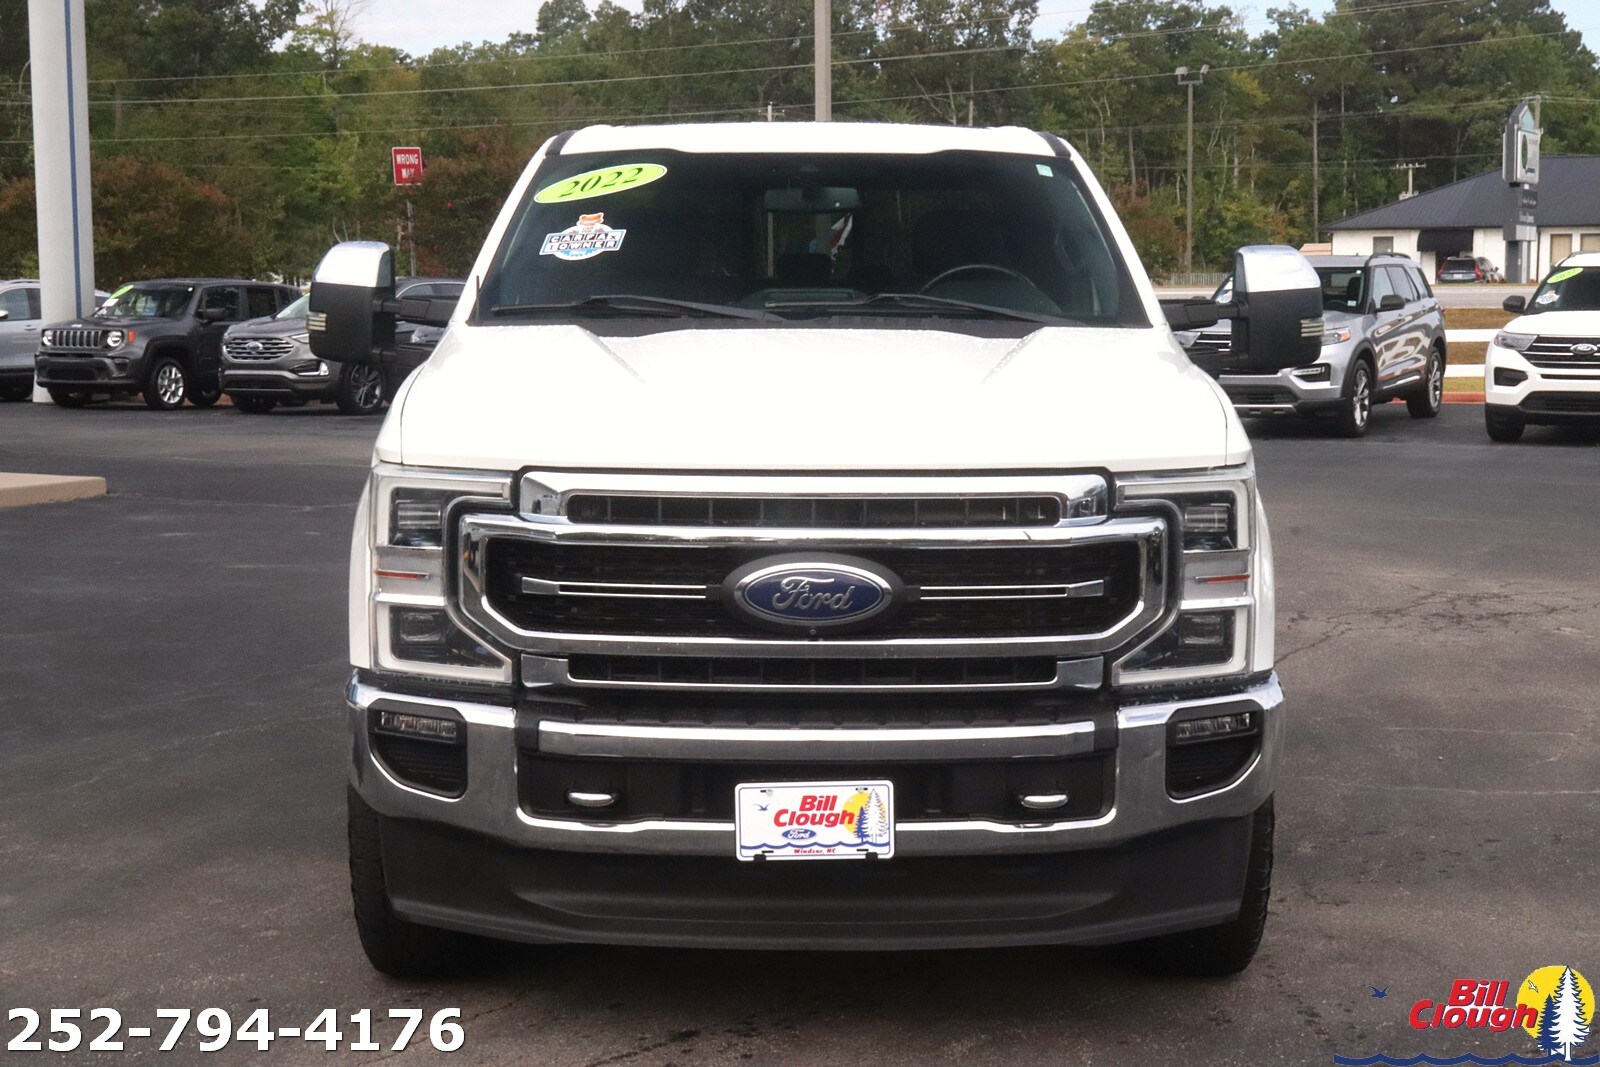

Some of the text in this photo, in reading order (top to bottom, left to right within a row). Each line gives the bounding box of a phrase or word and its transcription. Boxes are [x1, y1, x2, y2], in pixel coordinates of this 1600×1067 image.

[395, 153, 419, 165] WRONG
[401, 168, 415, 179] WAY
[557, 167, 644, 198] 2022
[549, 233, 618, 244] CARFAX
[557, 240, 618, 251] OWNER
[772, 575, 855, 610] Ford
[799, 795, 838, 812] Bill
[773, 808, 855, 828] Clough
[787, 829, 811, 840] Ford
